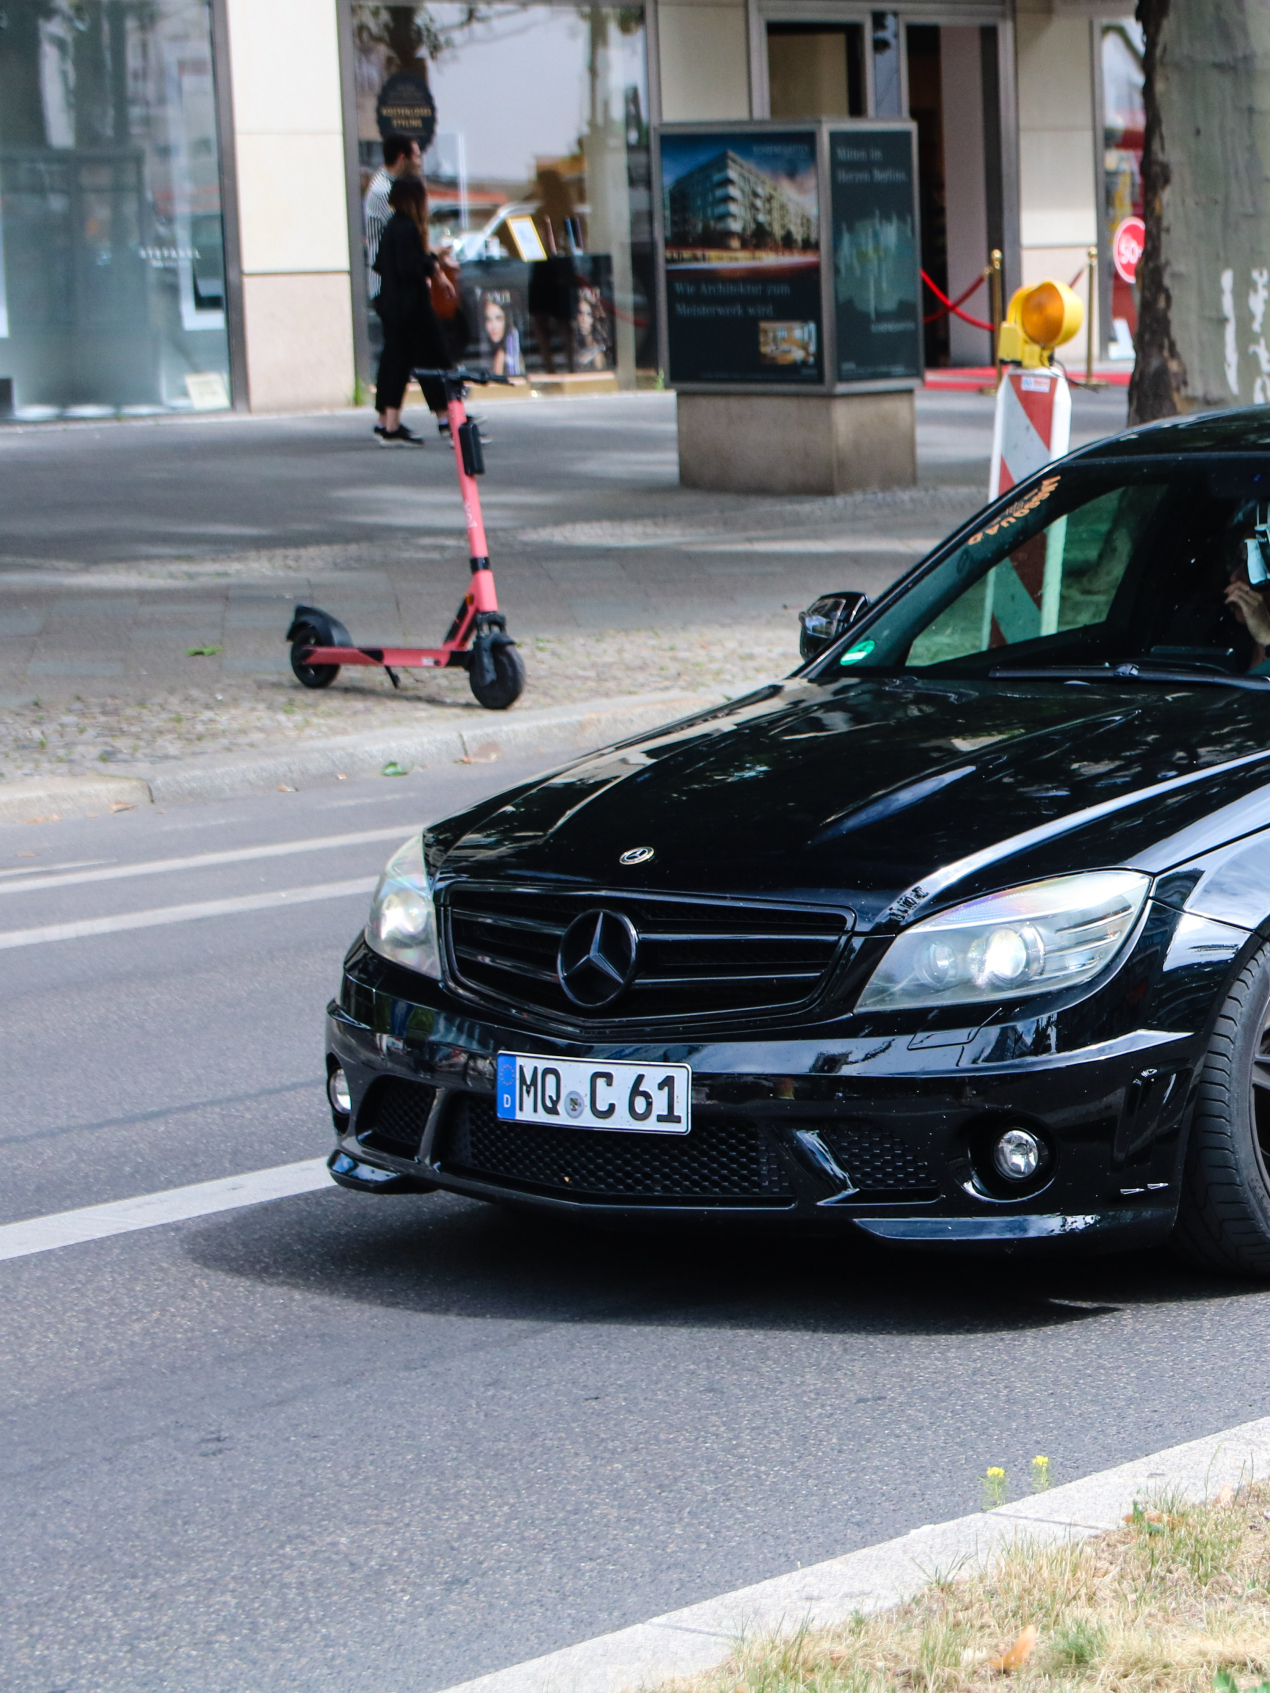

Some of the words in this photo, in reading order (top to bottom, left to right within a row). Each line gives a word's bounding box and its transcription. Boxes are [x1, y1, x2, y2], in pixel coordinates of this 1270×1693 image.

[674, 281, 697, 295] Wie
[675, 302, 744, 317] Meisterwerk
[503, 1093, 512, 1108] D
[518, 1063, 562, 1117] MQ
[589, 1071, 617, 1120] C
[628, 1073, 683, 1124] 61
